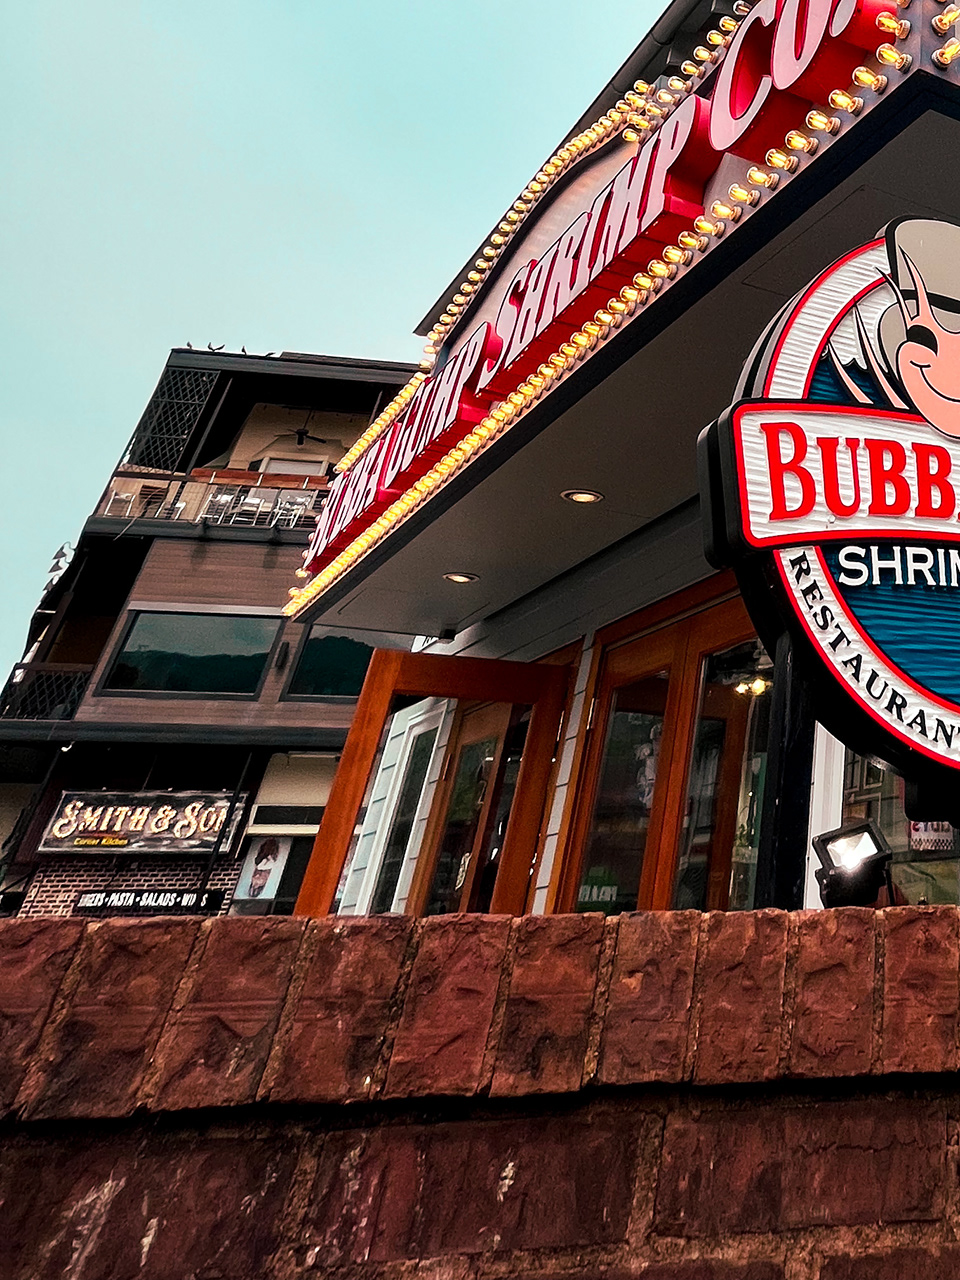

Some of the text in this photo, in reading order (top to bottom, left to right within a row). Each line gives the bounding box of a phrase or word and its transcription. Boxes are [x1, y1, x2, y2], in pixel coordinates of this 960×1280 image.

[384, 322, 486, 490] GUMP
[474, 93, 697, 395] SHRIMP
[53, 801, 151, 839] SMITH
[151, 805, 177, 834] &
[107, 892, 135, 907] PASTA
[139, 892, 177, 907] SALADS
[181, 893, 208, 907] WIS
